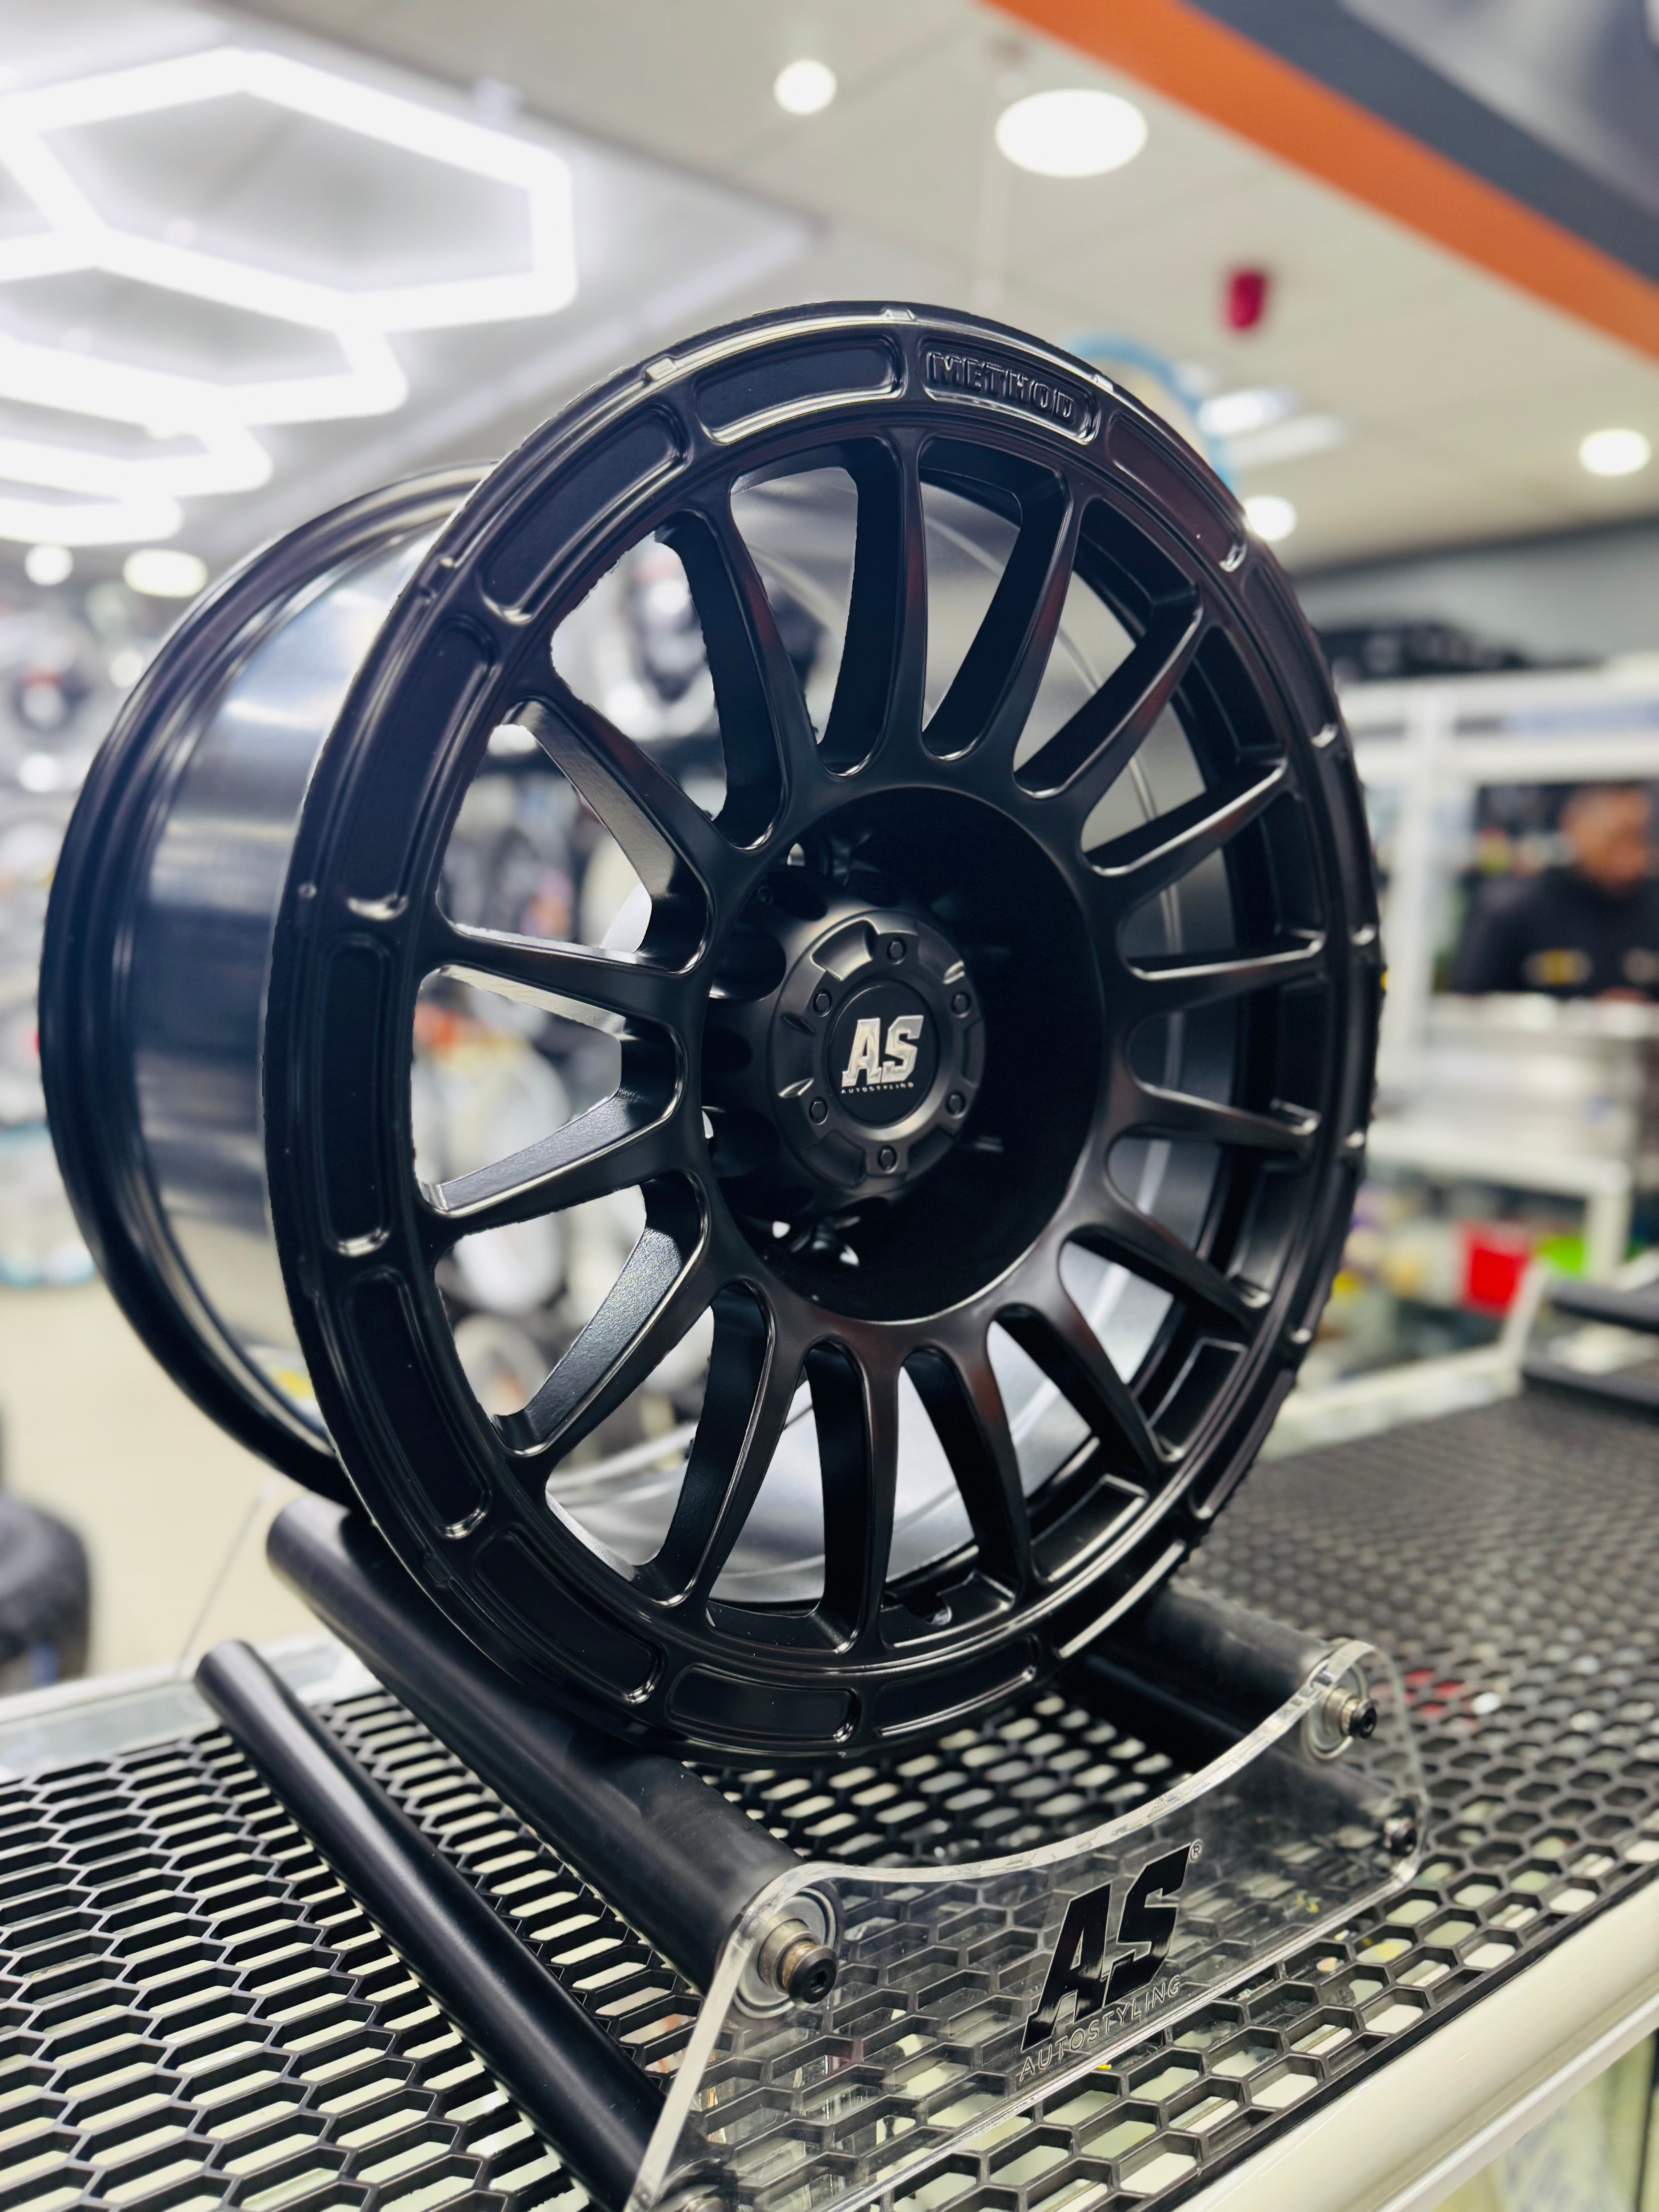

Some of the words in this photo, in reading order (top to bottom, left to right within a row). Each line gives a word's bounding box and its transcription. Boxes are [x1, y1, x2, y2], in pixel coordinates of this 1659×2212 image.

[927, 352, 1075, 420] METHOD
[842, 1015, 924, 1087] AS
[1019, 1974, 1182, 2082] AUTOSTYLING
